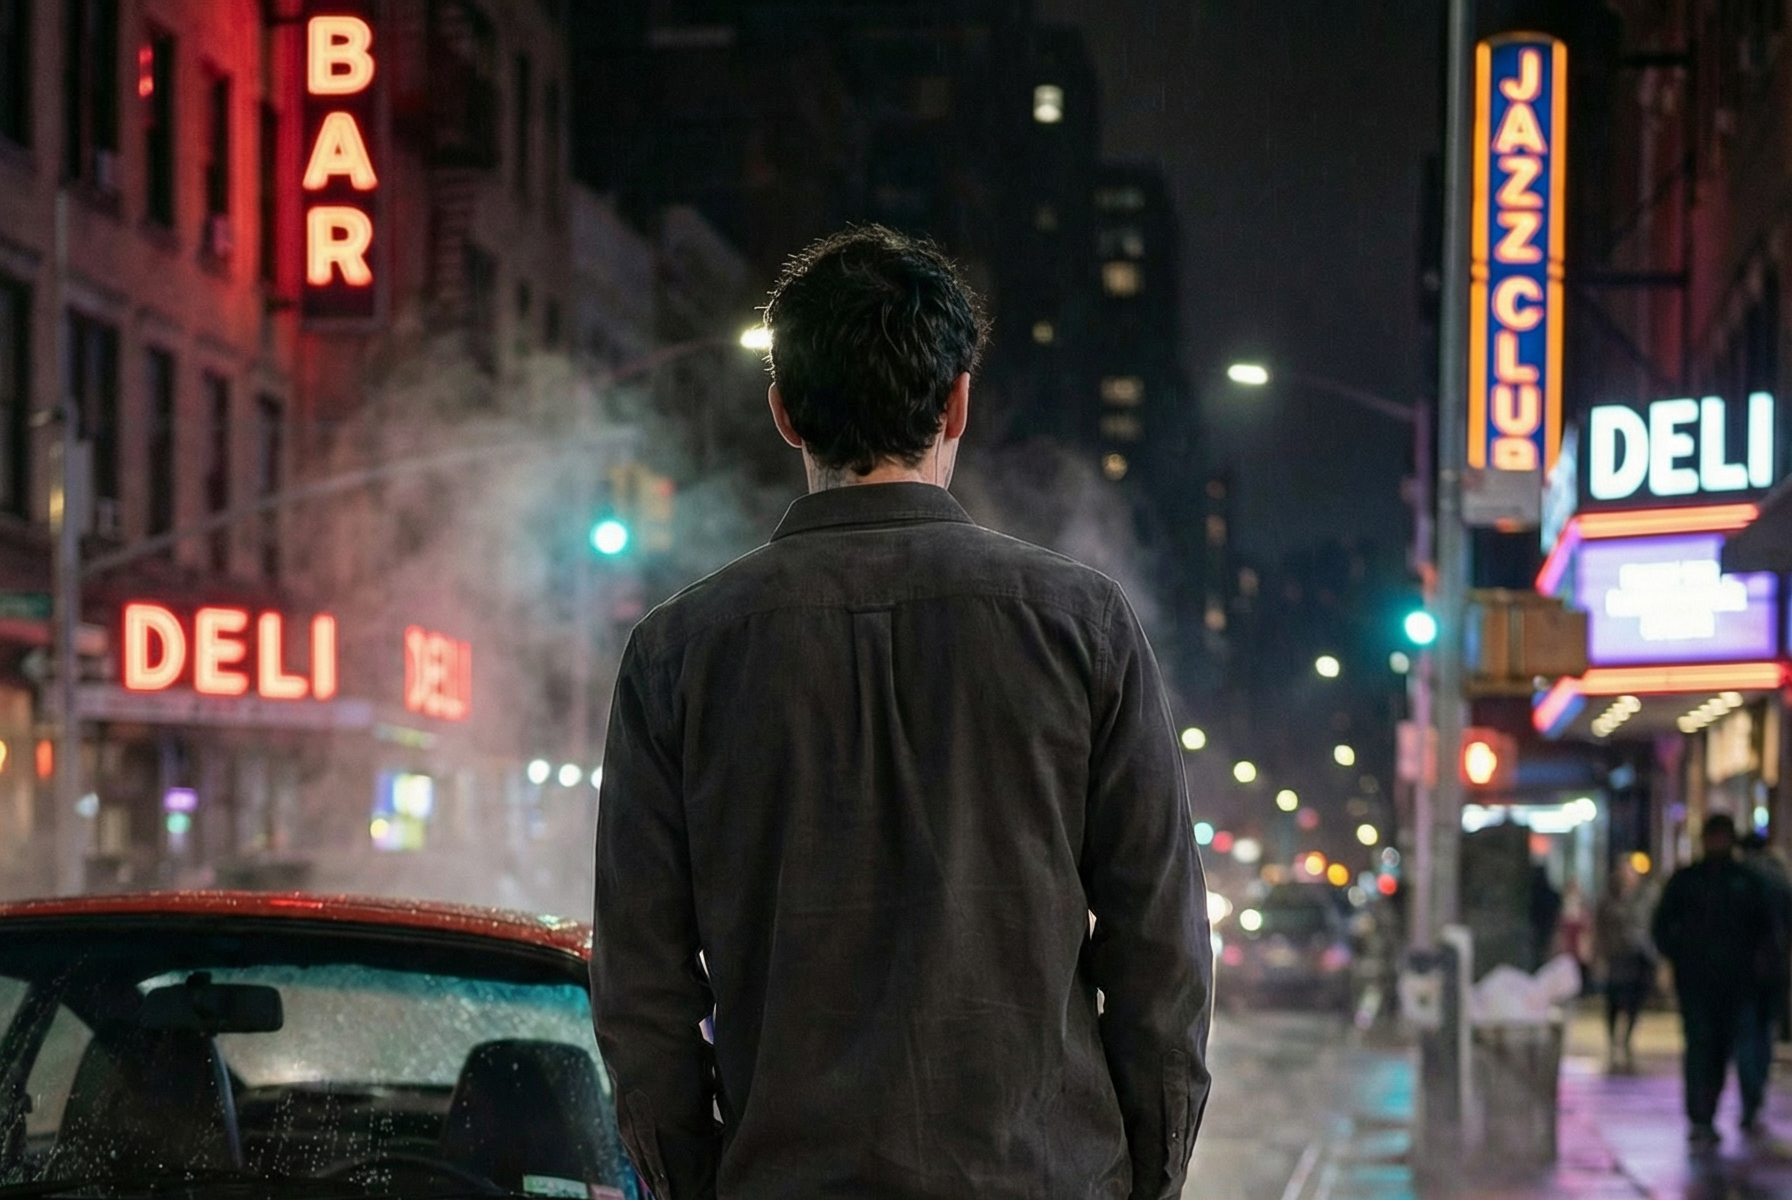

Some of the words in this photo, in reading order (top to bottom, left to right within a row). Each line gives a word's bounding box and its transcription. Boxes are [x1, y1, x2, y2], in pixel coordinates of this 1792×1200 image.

[303, 16, 378, 286] BAR
[1492, 48, 1548, 263] JAZZ
[1589, 391, 1774, 500] DELI
[125, 602, 337, 700] DELI
